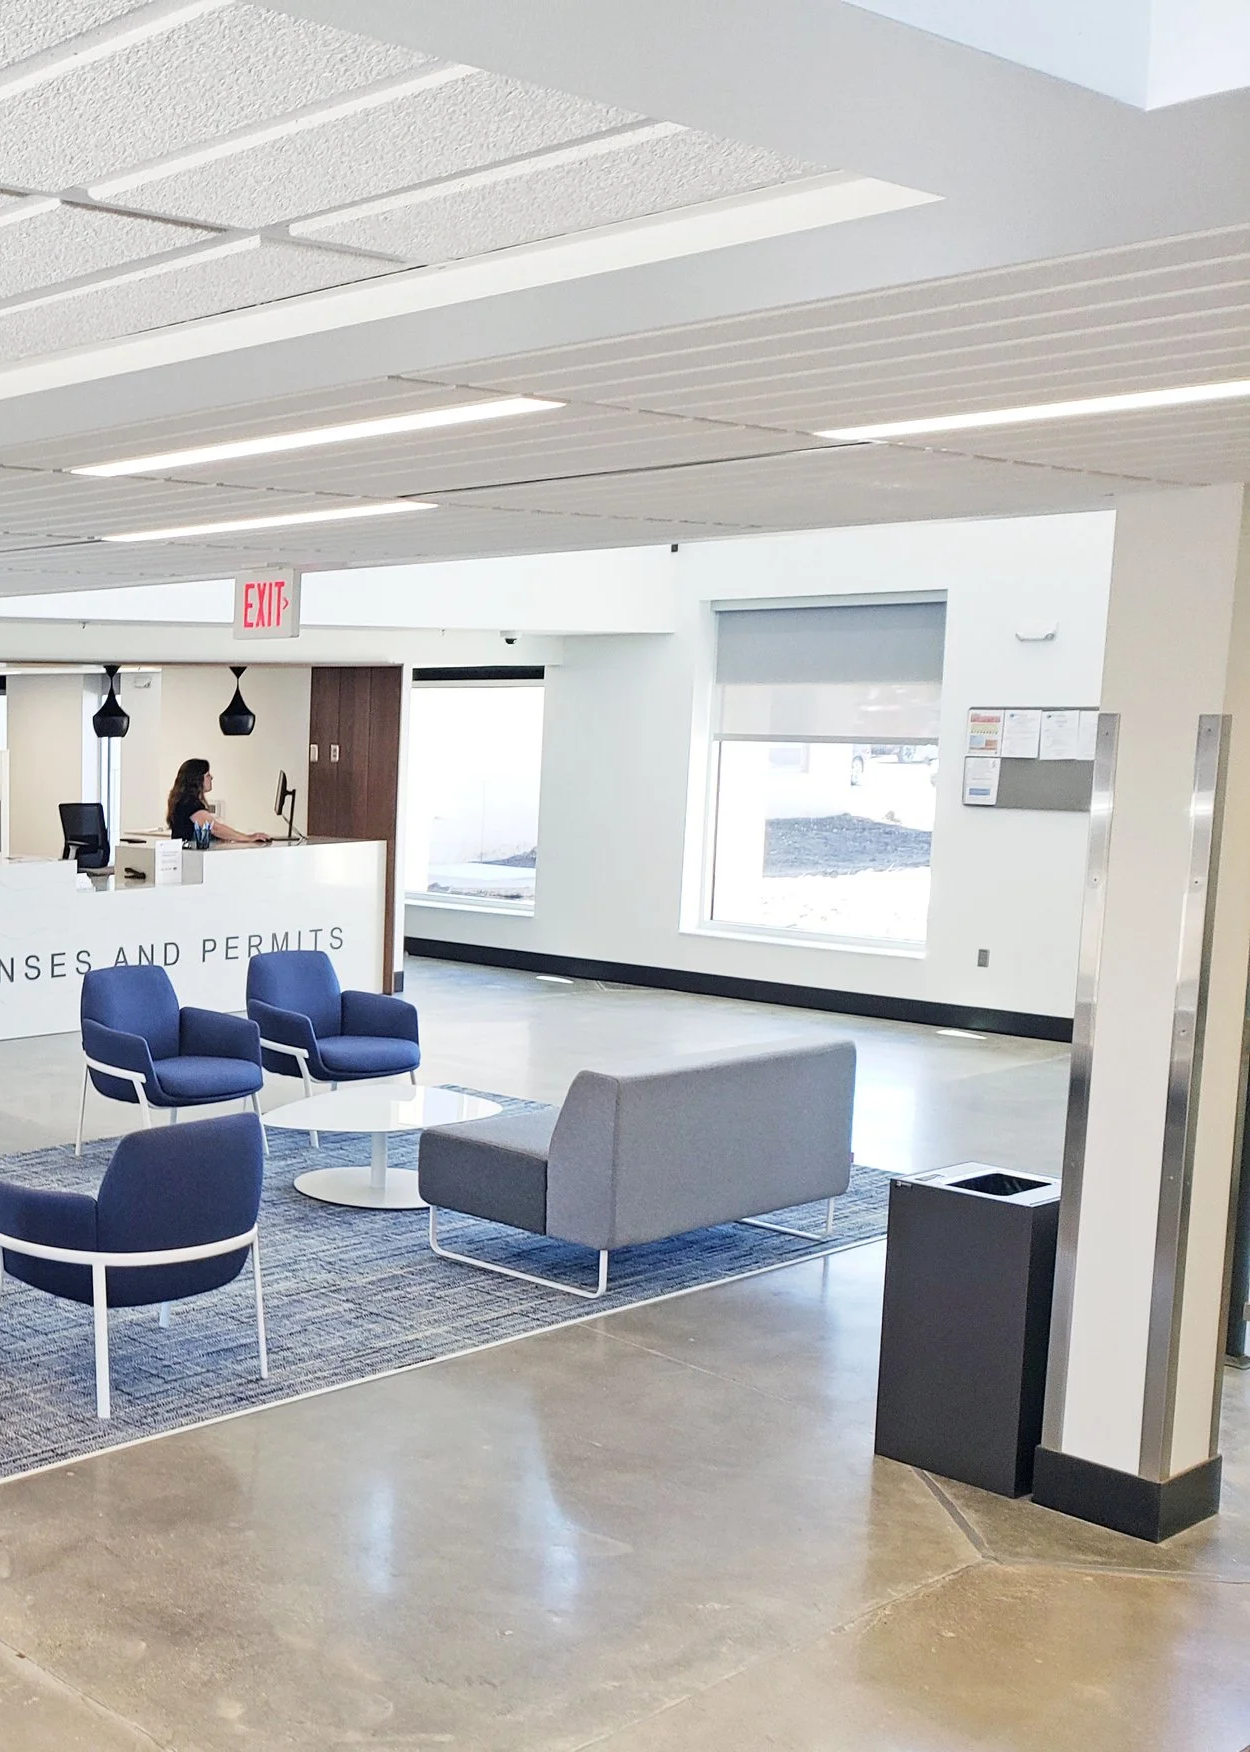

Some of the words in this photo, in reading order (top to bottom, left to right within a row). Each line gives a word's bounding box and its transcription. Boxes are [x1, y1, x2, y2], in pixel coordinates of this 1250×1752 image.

[243, 581, 285, 628] EXIT
[113, 942, 180, 967] AND
[201, 927, 344, 963] PERMITS
